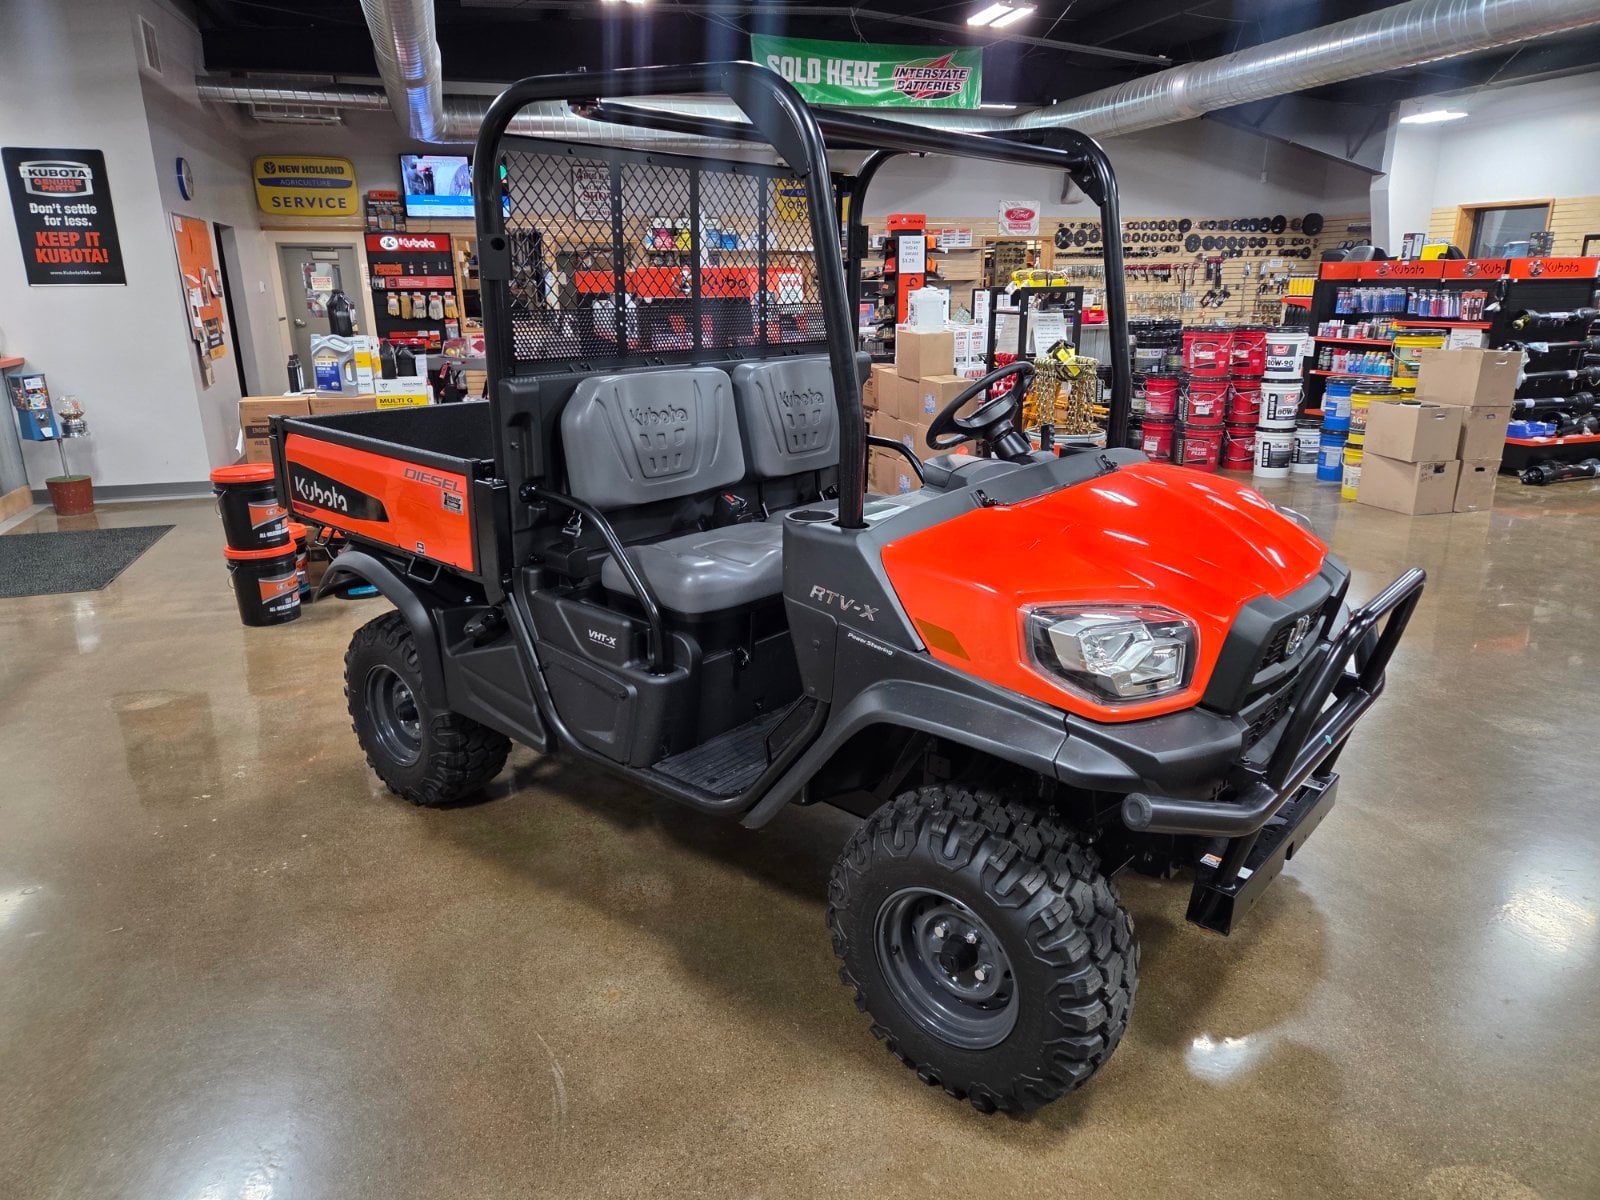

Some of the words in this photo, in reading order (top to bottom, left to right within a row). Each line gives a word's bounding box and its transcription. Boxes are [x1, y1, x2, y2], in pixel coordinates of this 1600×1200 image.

[767, 54, 821, 84] SOLD
[827, 58, 880, 87] HERE
[894, 66, 968, 80] INTERSTATE
[896, 80, 961, 91] BATTERIES
[28, 168, 87, 177] KUBOTA
[278, 165, 300, 173] NEW
[301, 165, 345, 175] HOLLAND
[33, 178, 82, 186] GENUINE
[280, 179, 331, 187] AGRICULTURE
[29, 202, 62, 214] Don't
[63, 203, 98, 215] settle
[271, 196, 347, 209] SERVICE
[44, 215, 62, 226] for
[64, 215, 92, 226] less.
[35, 231, 80, 247] KEEP
[85, 231, 100, 247] IT
[398, 237, 436, 249] Kubota
[35, 248, 109, 263] KUBOTA!
[1391, 264, 1425, 275] Kubota
[1481, 263, 1505, 274] Kub
[1545, 262, 1580, 273] Kubota
[779, 388, 824, 408] Kubota
[629, 403, 688, 426] Kubota
[404, 467, 463, 494] DIESEL
[294, 476, 348, 513] Kubota
[809, 584, 880, 621] RTV-X
[588, 629, 617, 646] VHT-X
[847, 632, 866, 643] Power
[865, 640, 894, 656] Steering
